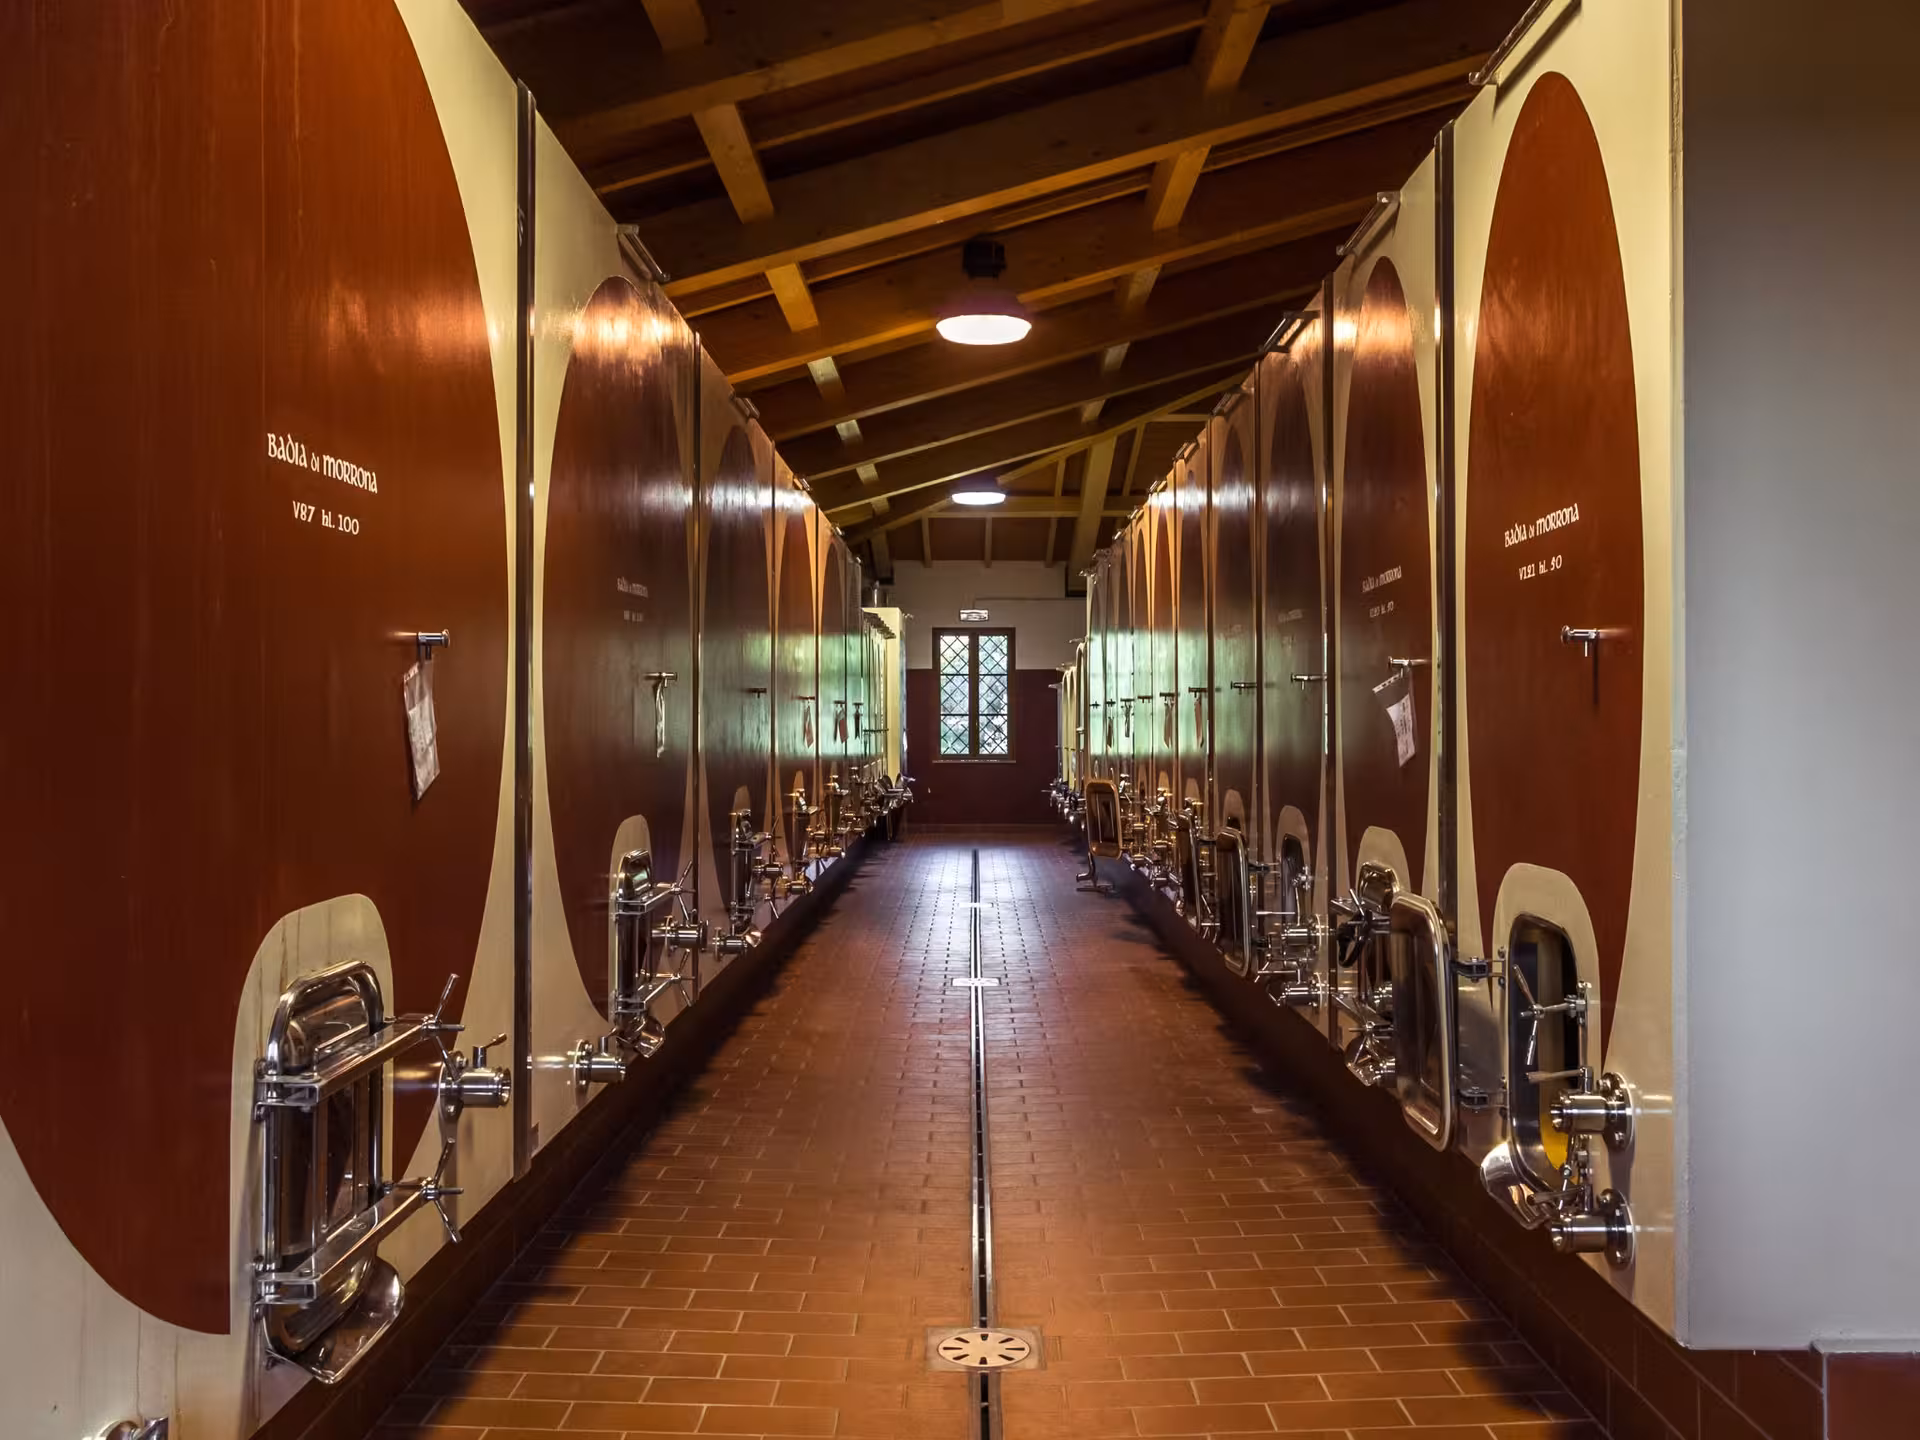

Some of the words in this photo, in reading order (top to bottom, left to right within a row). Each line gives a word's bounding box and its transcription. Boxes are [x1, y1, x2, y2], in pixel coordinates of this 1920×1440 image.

[292, 500, 316, 523] V87
[337, 513, 360, 535] 100
[1550, 554, 1563, 572] 50
